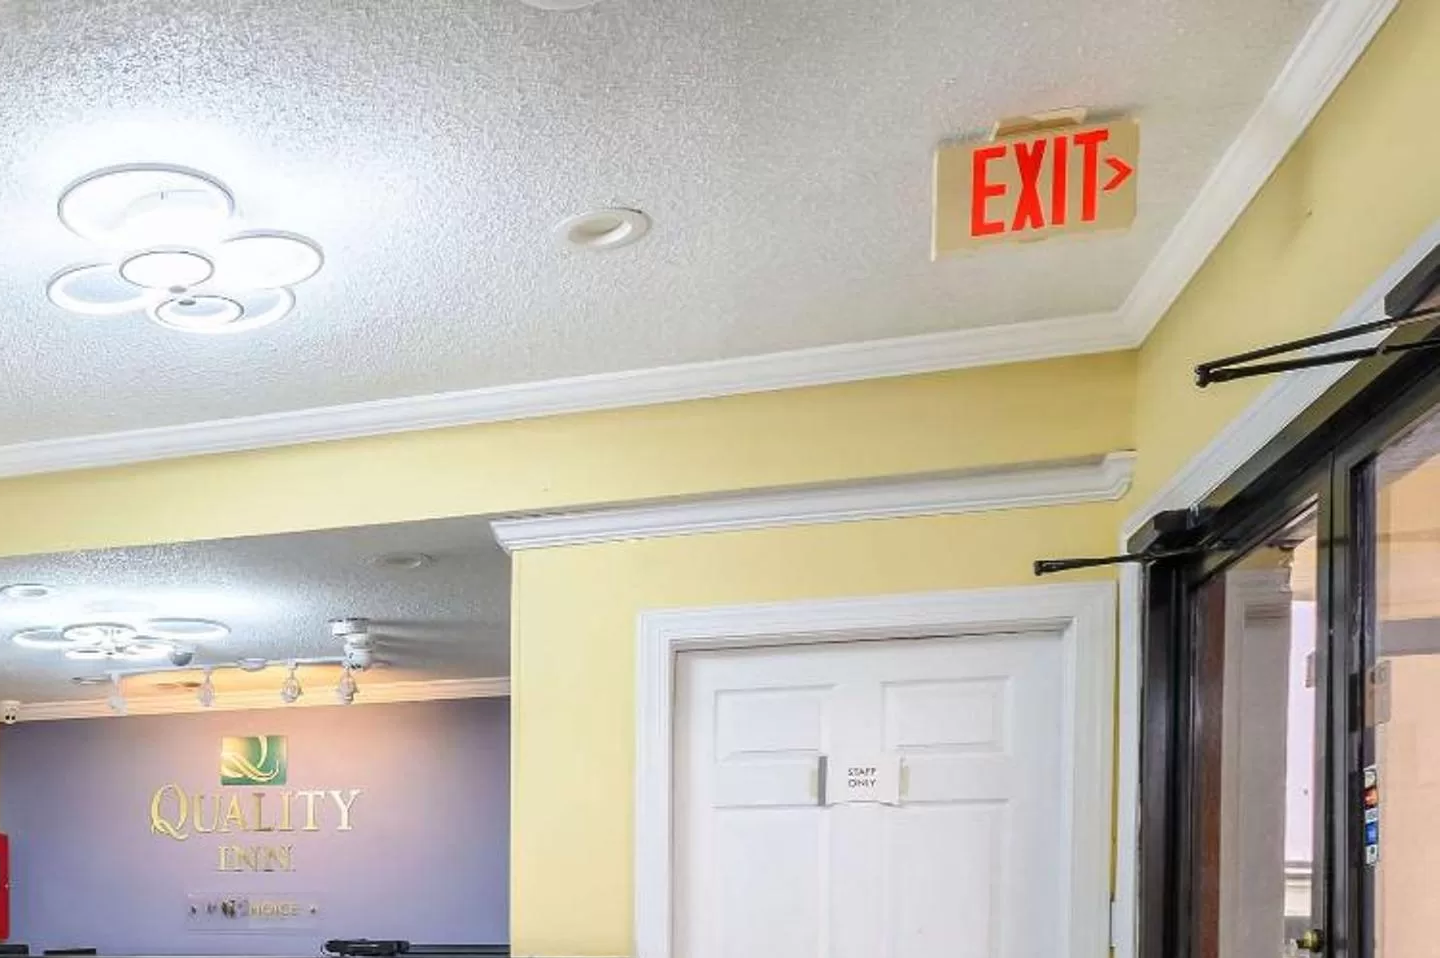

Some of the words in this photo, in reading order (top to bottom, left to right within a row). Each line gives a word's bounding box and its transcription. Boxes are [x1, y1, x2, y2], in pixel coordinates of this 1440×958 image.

[970, 128, 1109, 237] EXIT
[847, 767, 876, 777] STAFF
[847, 779, 876, 788] ONLY
[150, 782, 363, 841] QUALITY
[216, 844, 297, 873] INN
